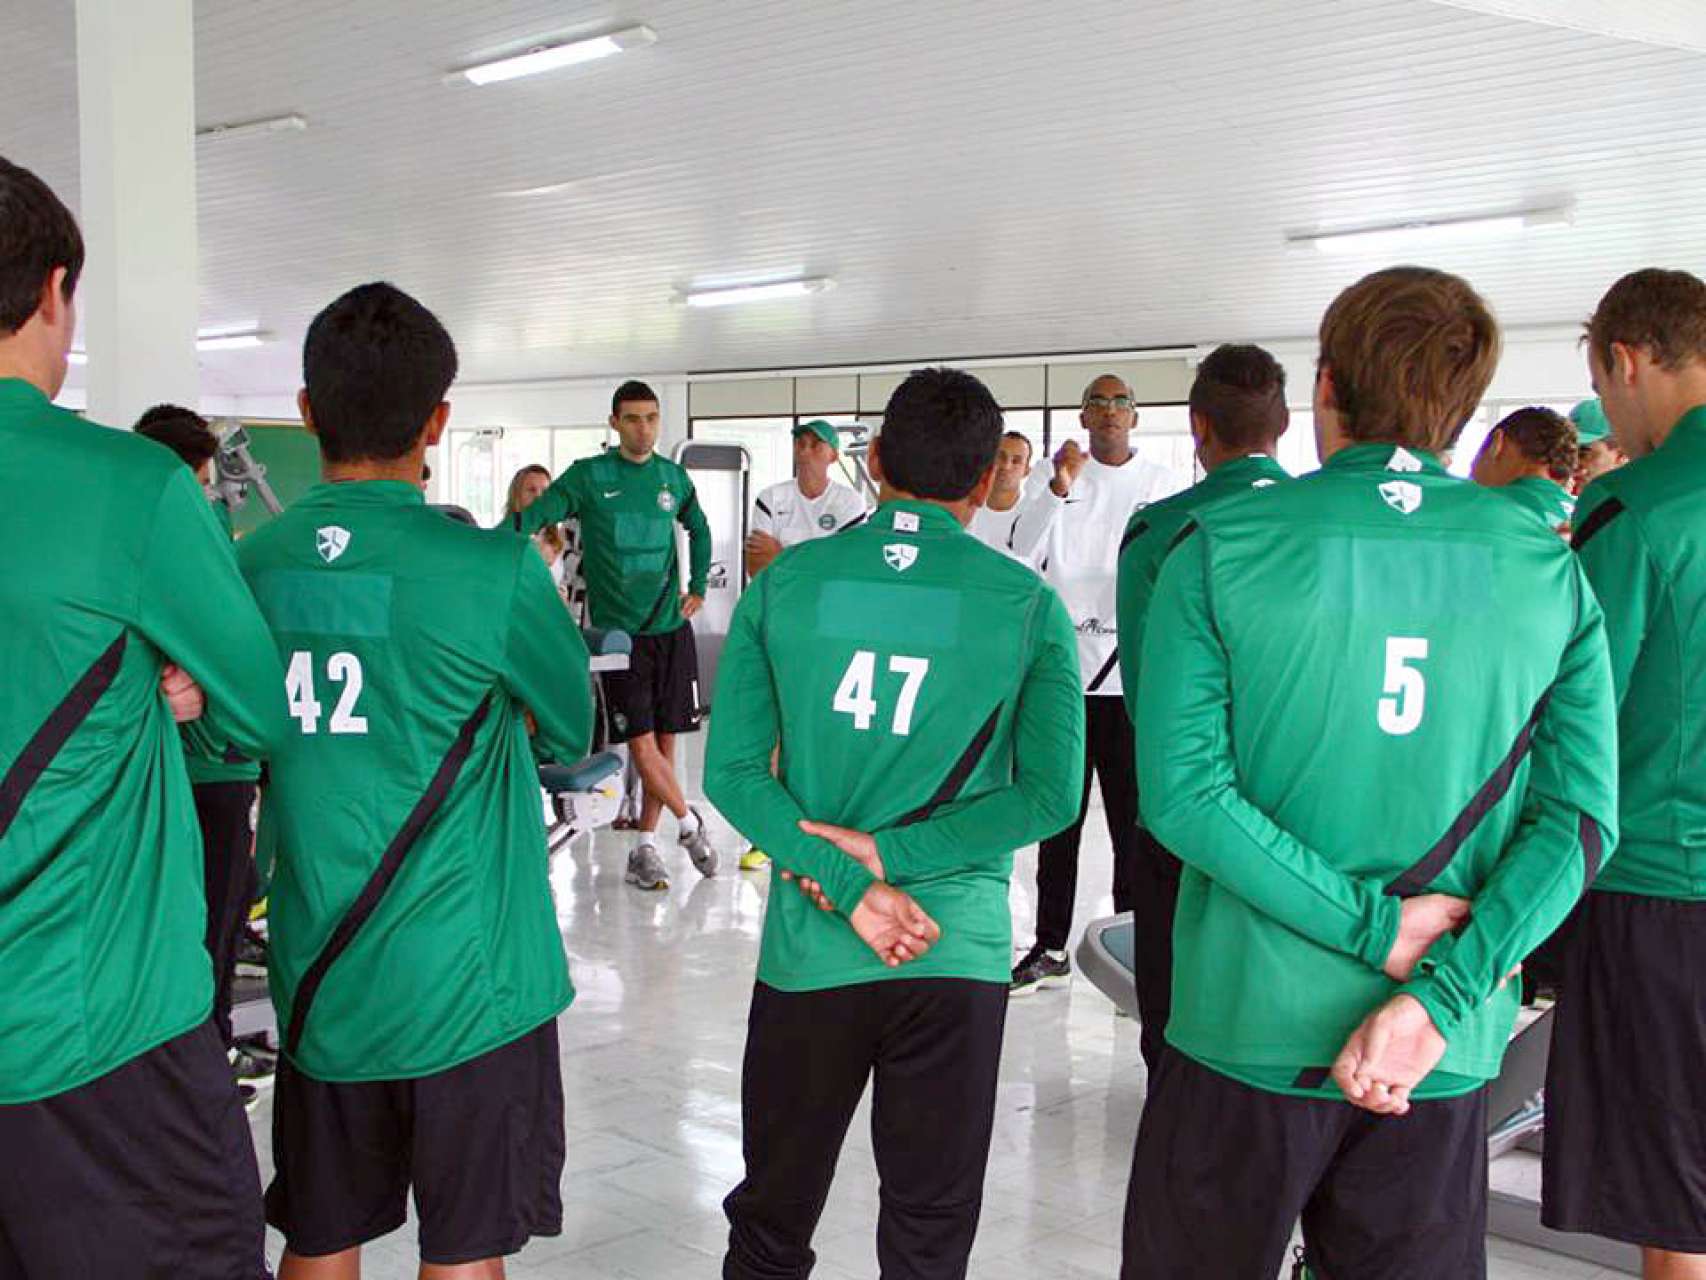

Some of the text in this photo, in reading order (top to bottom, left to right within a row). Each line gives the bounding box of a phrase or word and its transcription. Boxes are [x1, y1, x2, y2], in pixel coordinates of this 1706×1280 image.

[286, 651, 367, 733] 42
[832, 650, 929, 736] 47
[1377, 636, 1428, 735] 5
